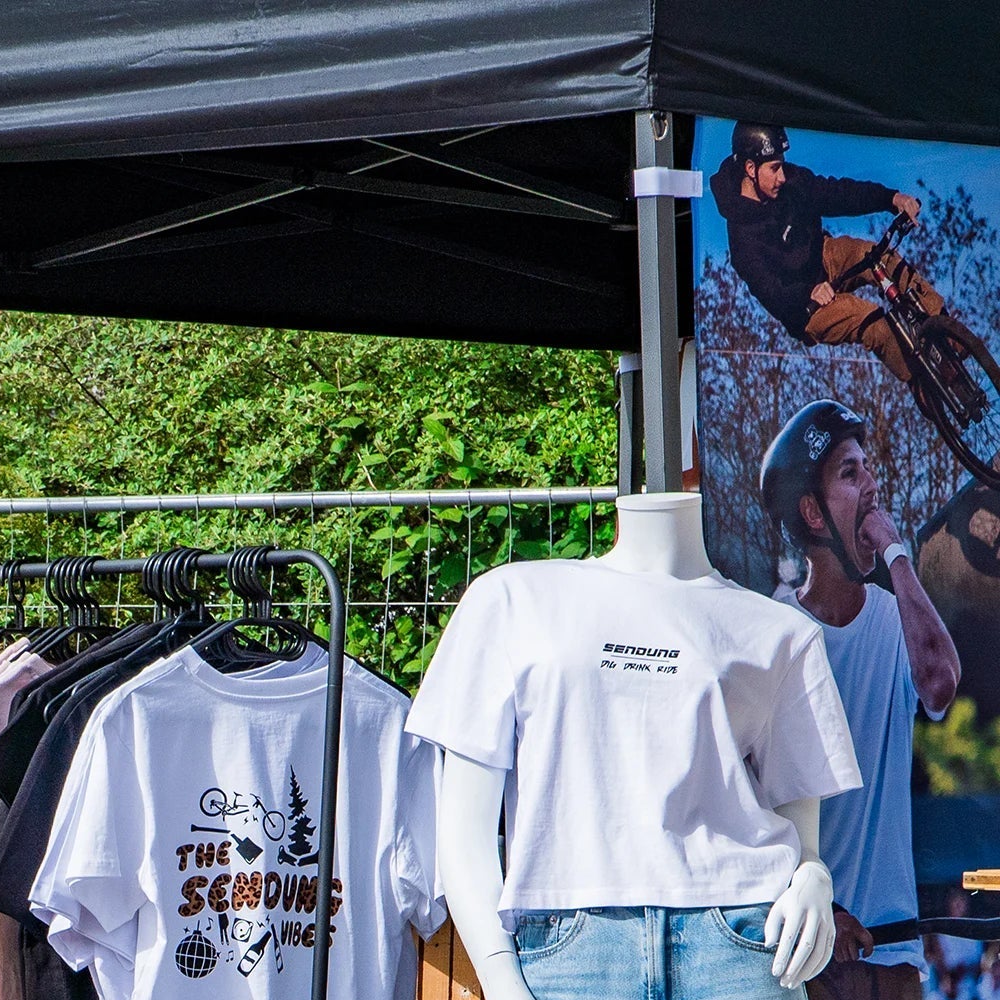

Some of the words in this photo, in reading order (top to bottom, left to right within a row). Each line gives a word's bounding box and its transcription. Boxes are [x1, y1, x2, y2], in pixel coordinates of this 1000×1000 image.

[602, 643, 680, 659] SENDUNG
[600, 660, 617, 669] DIG
[623, 662, 651, 672] DRINK
[656, 665, 679, 674] RIDE
[176, 841, 232, 871] THE
